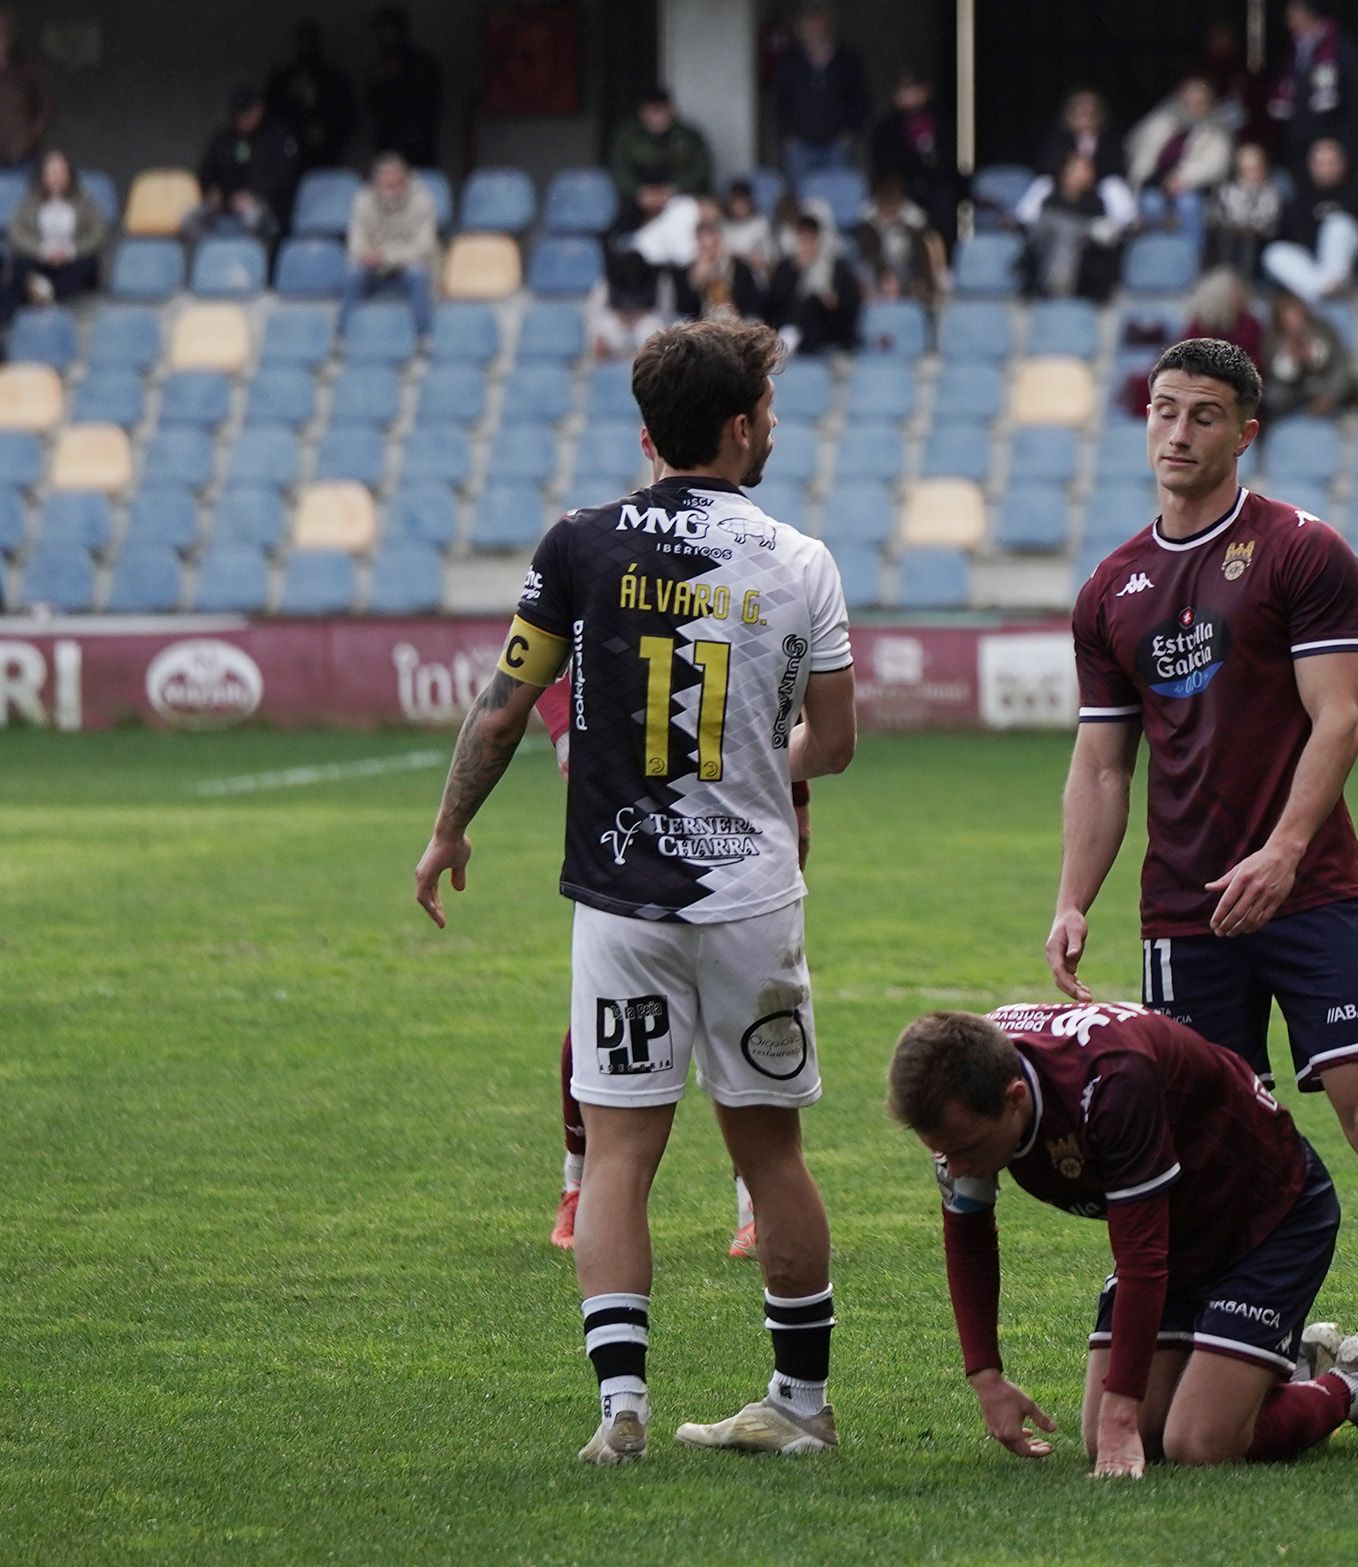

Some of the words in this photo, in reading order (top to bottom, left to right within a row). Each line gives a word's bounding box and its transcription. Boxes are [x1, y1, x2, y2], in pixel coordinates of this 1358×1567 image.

[616, 504, 710, 539] MMG
[656, 543, 733, 560] IBÉRICOS
[620, 563, 731, 620] ÁLVARO
[741, 590, 767, 625] G.
[506, 635, 529, 668] C
[1157, 645, 1212, 678] Galcia
[639, 635, 731, 781] 11
[649, 813, 763, 835] TERNERA
[658, 836, 760, 857] CHARRA
[1143, 938, 1174, 1002] 11
